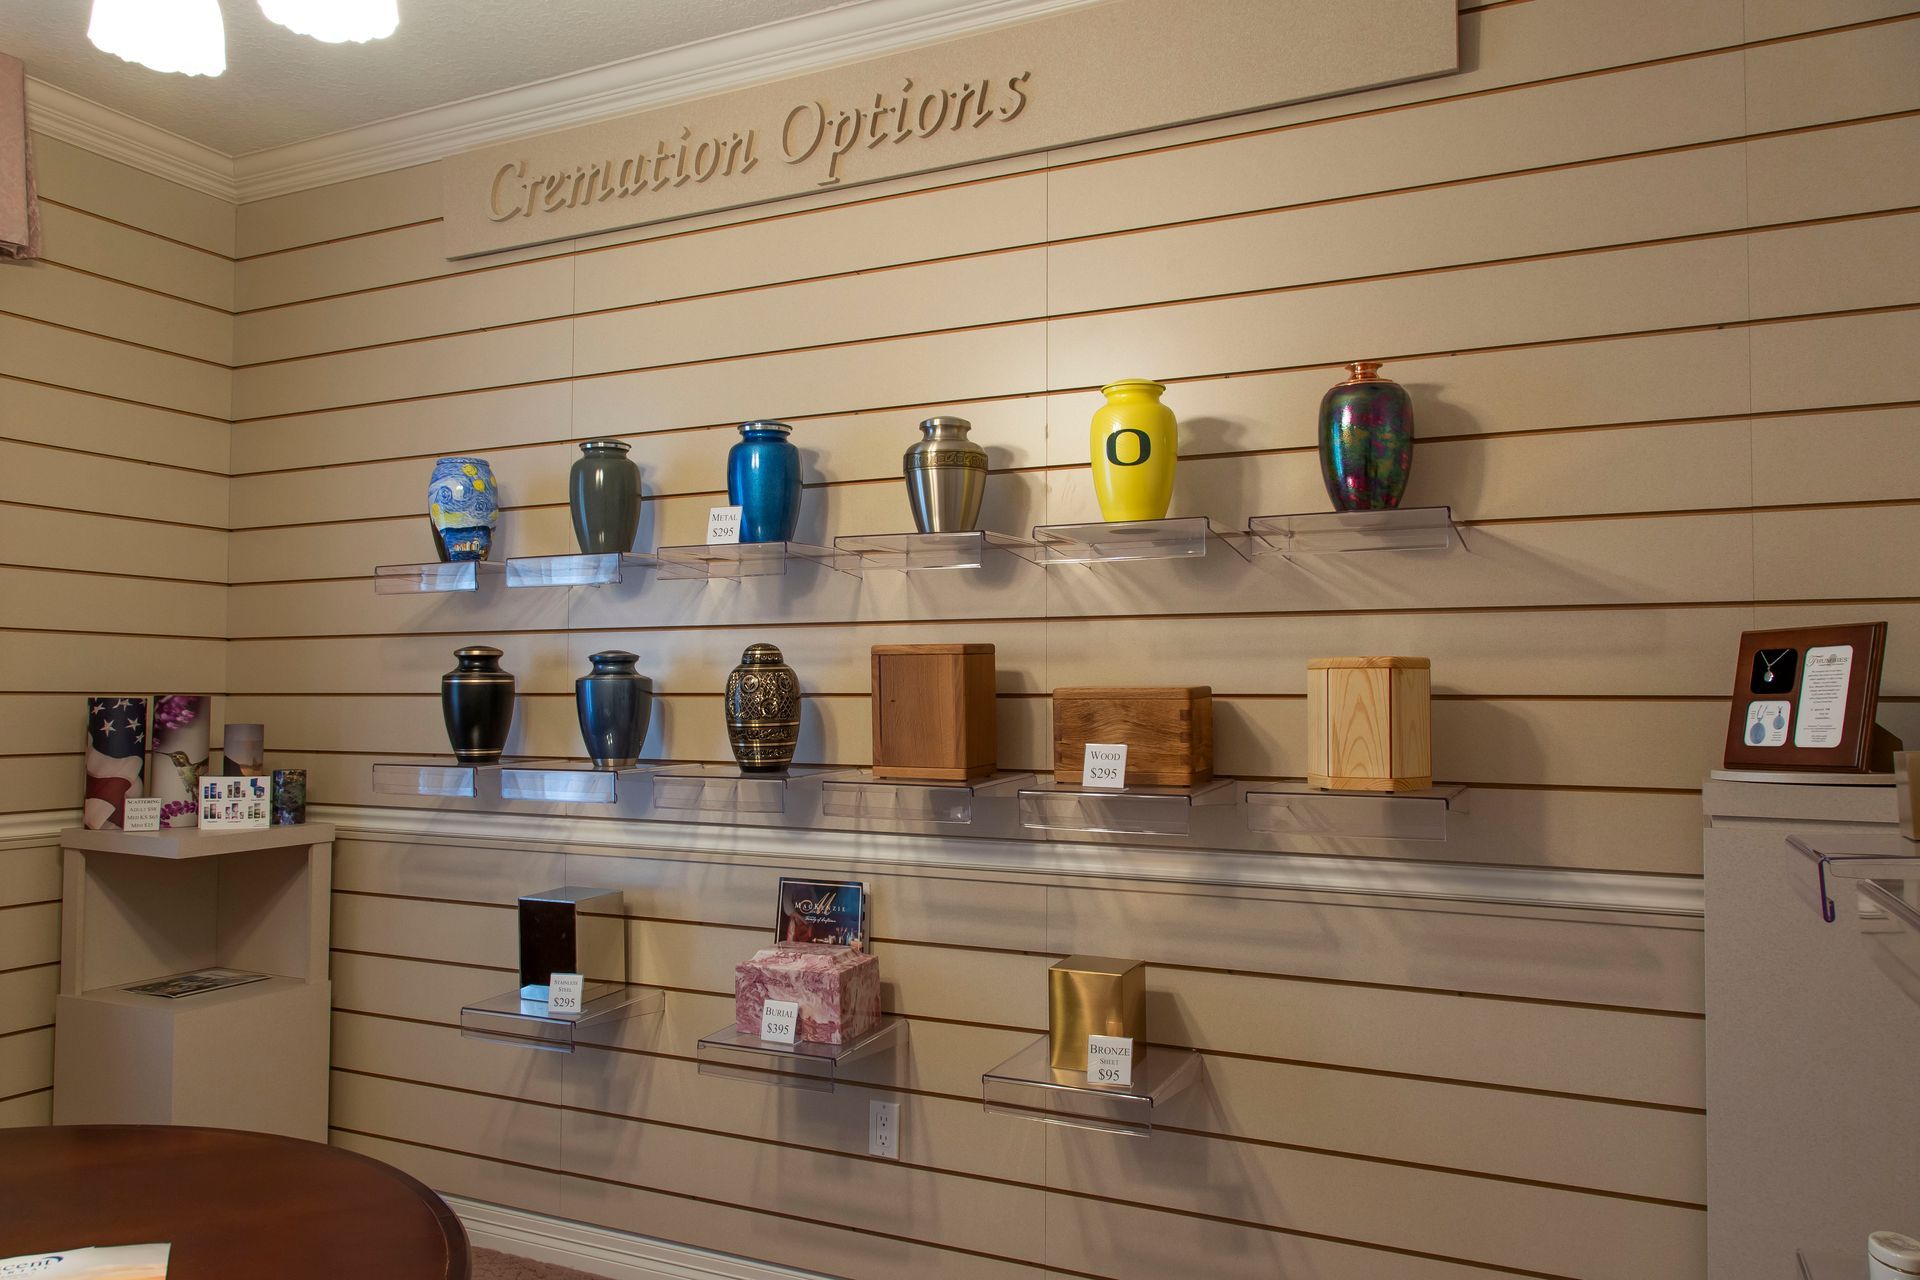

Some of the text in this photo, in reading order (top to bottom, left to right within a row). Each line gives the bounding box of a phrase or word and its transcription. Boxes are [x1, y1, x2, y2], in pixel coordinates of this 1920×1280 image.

[490, 70, 1031, 223] Cremation Options
[1107, 429, 1151, 467] O
[712, 527, 733, 537] $295
[1091, 751, 1121, 761] WOOD
[1090, 767, 1117, 780] $295
[553, 997, 576, 1008] $295
[765, 1006, 794, 1019] BURIAL
[767, 1022, 789, 1036] $395
[1090, 1044, 1131, 1057] BRONZE
[1098, 1068, 1120, 1082] $95
